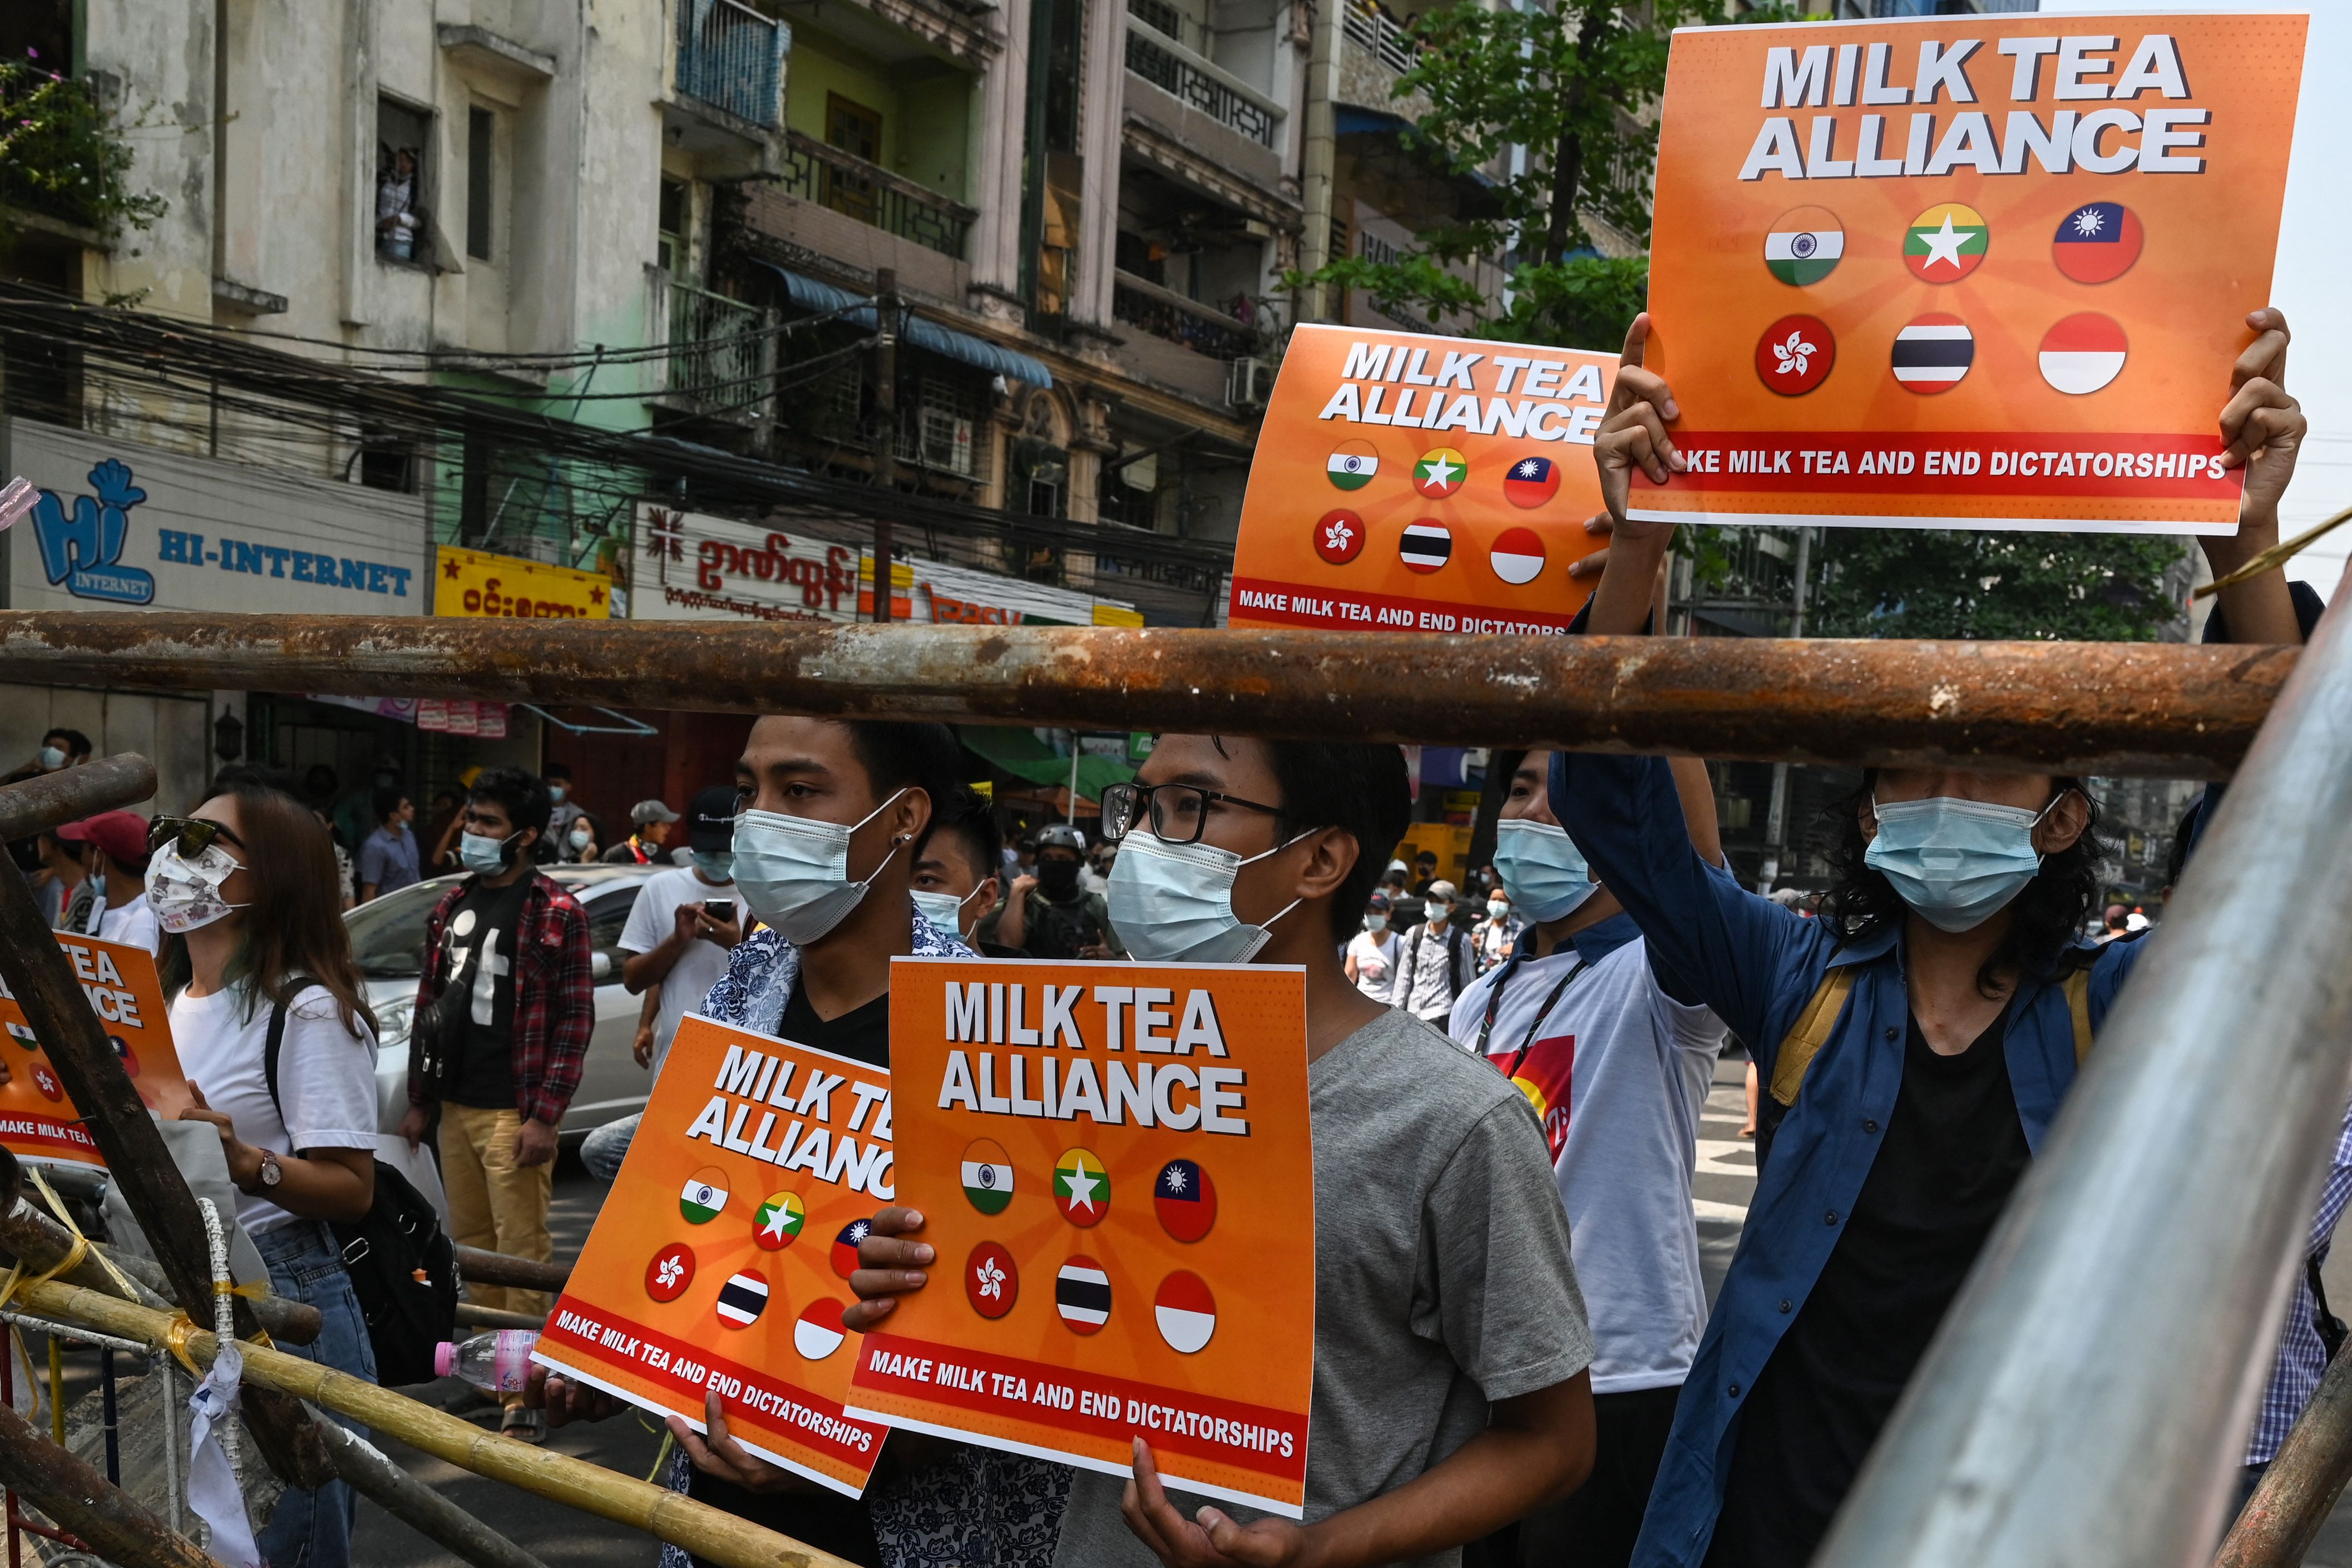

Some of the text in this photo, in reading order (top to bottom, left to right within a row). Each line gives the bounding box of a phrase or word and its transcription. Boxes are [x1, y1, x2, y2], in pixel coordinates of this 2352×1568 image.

[1761, 34, 2187, 107] MILK TEA
[1738, 108, 2207, 180] ALLIANCE
[1342, 343, 1602, 403] MILK TEA
[1319, 383, 1606, 446] ALLIANCE
[1728, 450, 1791, 473] MILK
[1800, 451, 1850, 474] TEA
[1858, 451, 1914, 474] AND
[1923, 451, 1980, 475] END
[1990, 451, 2226, 480] DICTATORSHIPS
[75, 572, 150, 596] INTERNET
[159, 529, 412, 596] HI-INTERNET
[1239, 590, 1565, 635] MAKE MILK TEA AND END DICTATORS
[60, 943, 125, 987] EA
[945, 981, 1226, 1056] MILK TEA
[715, 1045, 892, 1141] MILK TE
[937, 1050, 1246, 1134] ALLIANCE
[0, 1120, 35, 1135] MAKE
[37, 1123, 67, 1139] MILK
[67, 1129, 89, 1145] TEA
[686, 1096, 895, 1200] ALLIANC
[556, 1309, 873, 1452] MAKE MILK TEA AND END DICTATORSHIPS
[869, 1350, 1293, 1457] MAKE MILK TEA AND END DICTATORSHIPS
